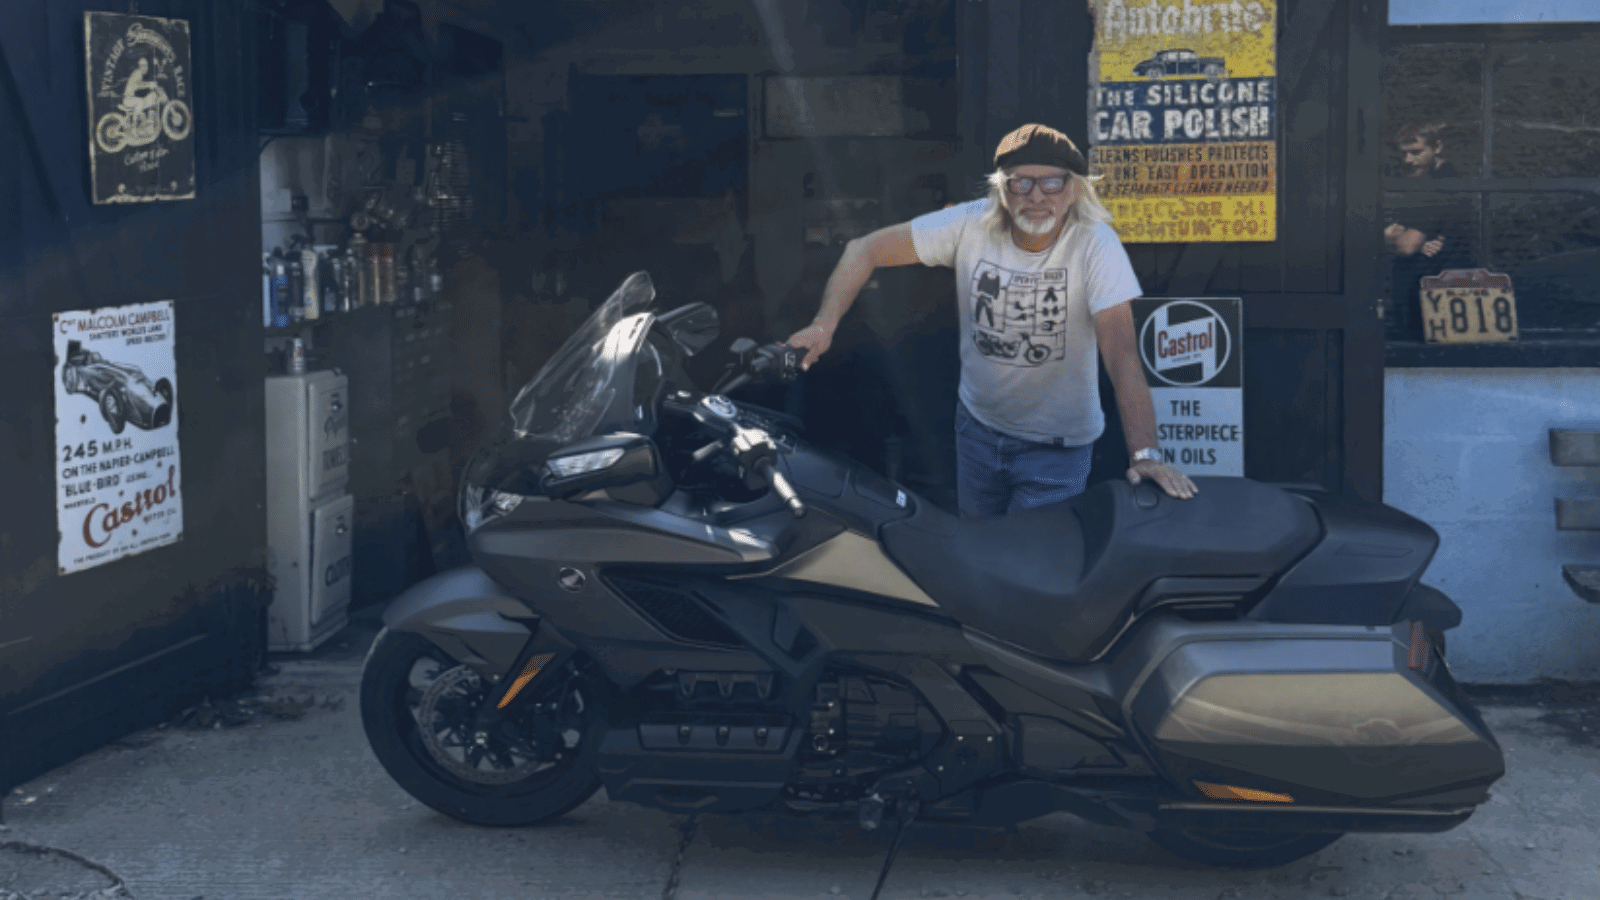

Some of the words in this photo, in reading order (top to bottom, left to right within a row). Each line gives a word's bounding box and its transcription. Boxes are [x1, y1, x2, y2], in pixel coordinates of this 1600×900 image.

[1096, 87, 1135, 106] THE
[1147, 81, 1271, 106] SILICONE
[1094, 109, 1152, 140] CAR
[1163, 106, 1269, 138] POLISH
[1189, 163, 1269, 181] OPERATION
[78, 315, 128, 331] MALCOLM
[128, 310, 170, 325] CAMPBELL
[1450, 296, 1513, 334] 818
[1157, 321, 1213, 359] Castrol
[1169, 399, 1201, 417] THE
[1157, 422, 1240, 442] STERPIECE
[62, 439, 99, 463] 245
[1160, 447, 1176, 464] N
[1181, 447, 1217, 466] OILS
[62, 465, 79, 480] ON
[80, 462, 98, 476] THE
[83, 464, 176, 549] Castrol
